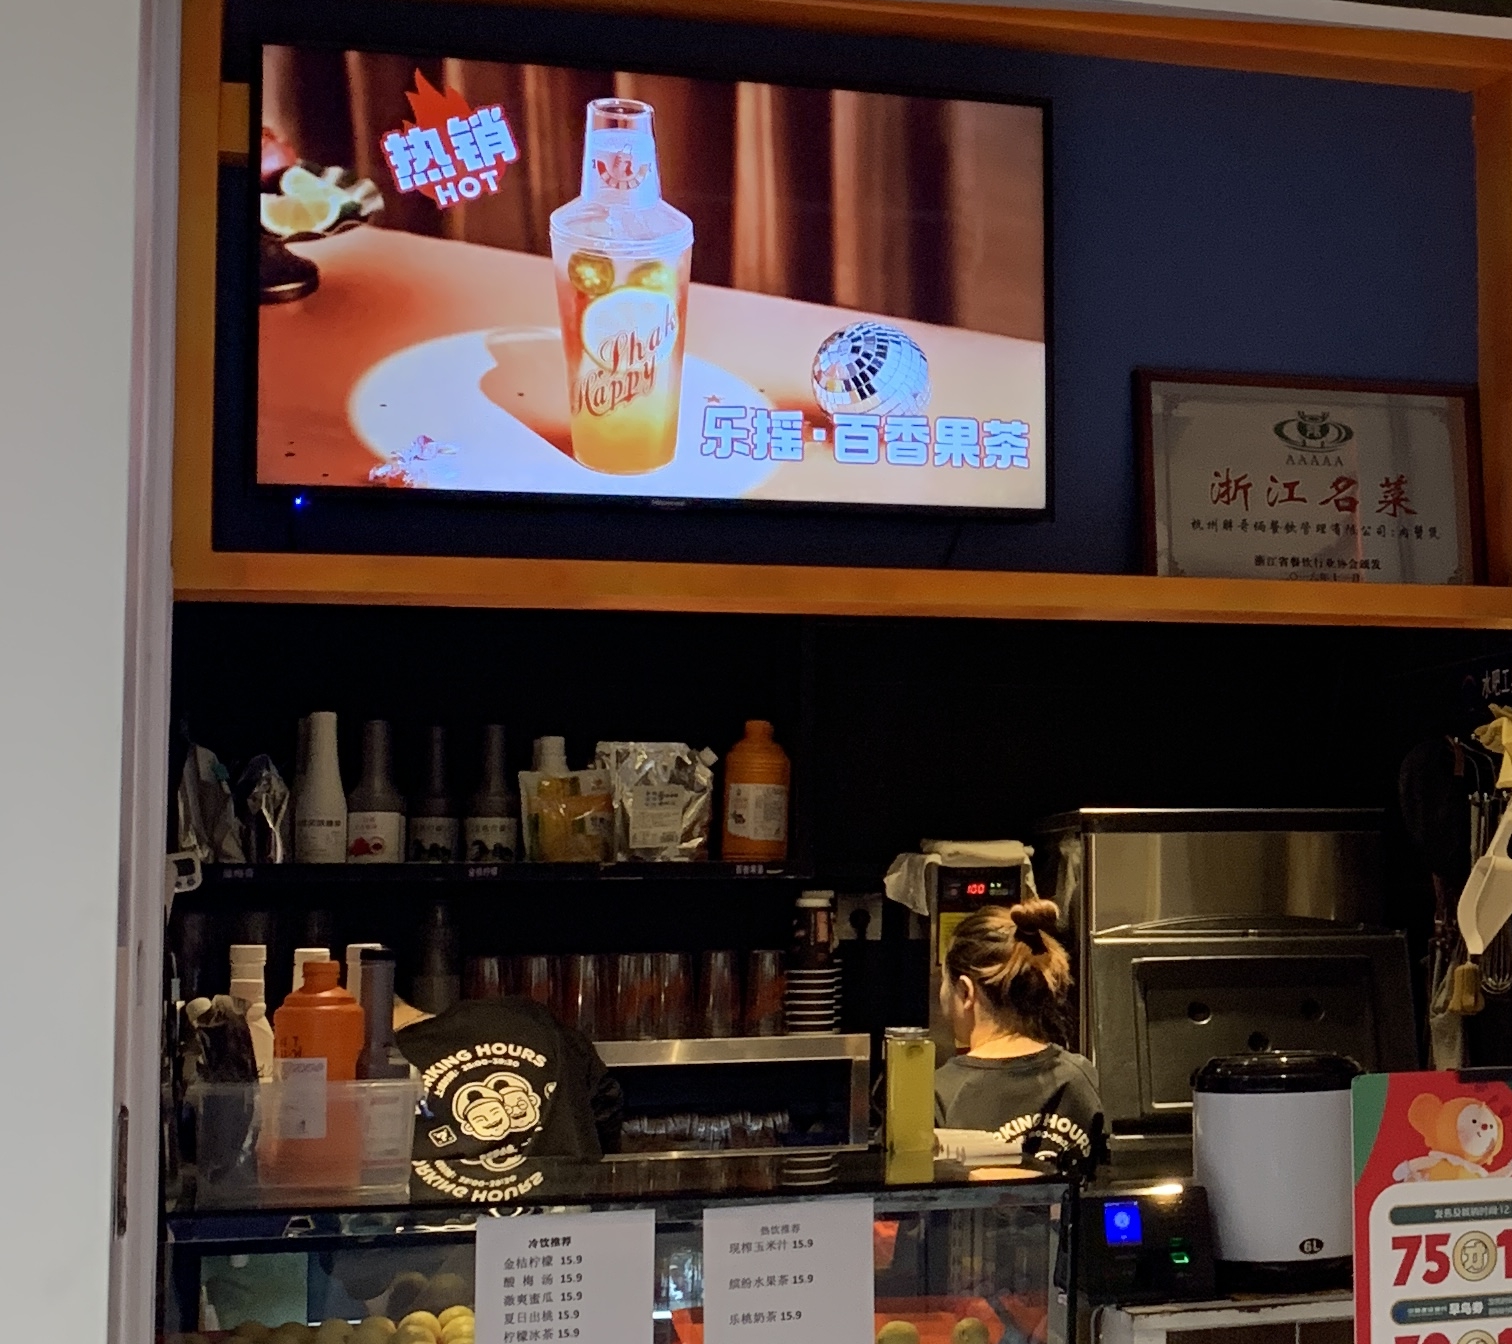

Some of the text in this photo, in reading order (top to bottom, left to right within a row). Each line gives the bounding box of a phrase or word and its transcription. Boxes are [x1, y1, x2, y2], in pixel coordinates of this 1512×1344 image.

[383, 106, 517, 191] 热销
[435, 170, 498, 206] HOT
[571, 356, 657, 417] Happy
[700, 406, 1030, 469] 乐摇·百香果茶
[1209, 467, 1418, 518] 浙江名菜
[474, 1042, 548, 1068] HOURS
[527, 1236, 572, 1249] 冷饮推荐
[728, 1238, 814, 1255] 现榨玉米汁 15.9
[1302, 1240, 1321, 1254] 6L
[503, 1254, 583, 1270] 金桔柠檬 15.9
[1391, 1232, 1452, 1286] 75
[560, 1273, 583, 1283] 15.9
[792, 1274, 814, 1285] 15.9
[560, 1291, 583, 1302] 15.9
[558, 1309, 580, 1321] 15.9
[780, 1310, 803, 1321] 15.9
[503, 1327, 580, 1343] 柠檬冰茶 15.9
